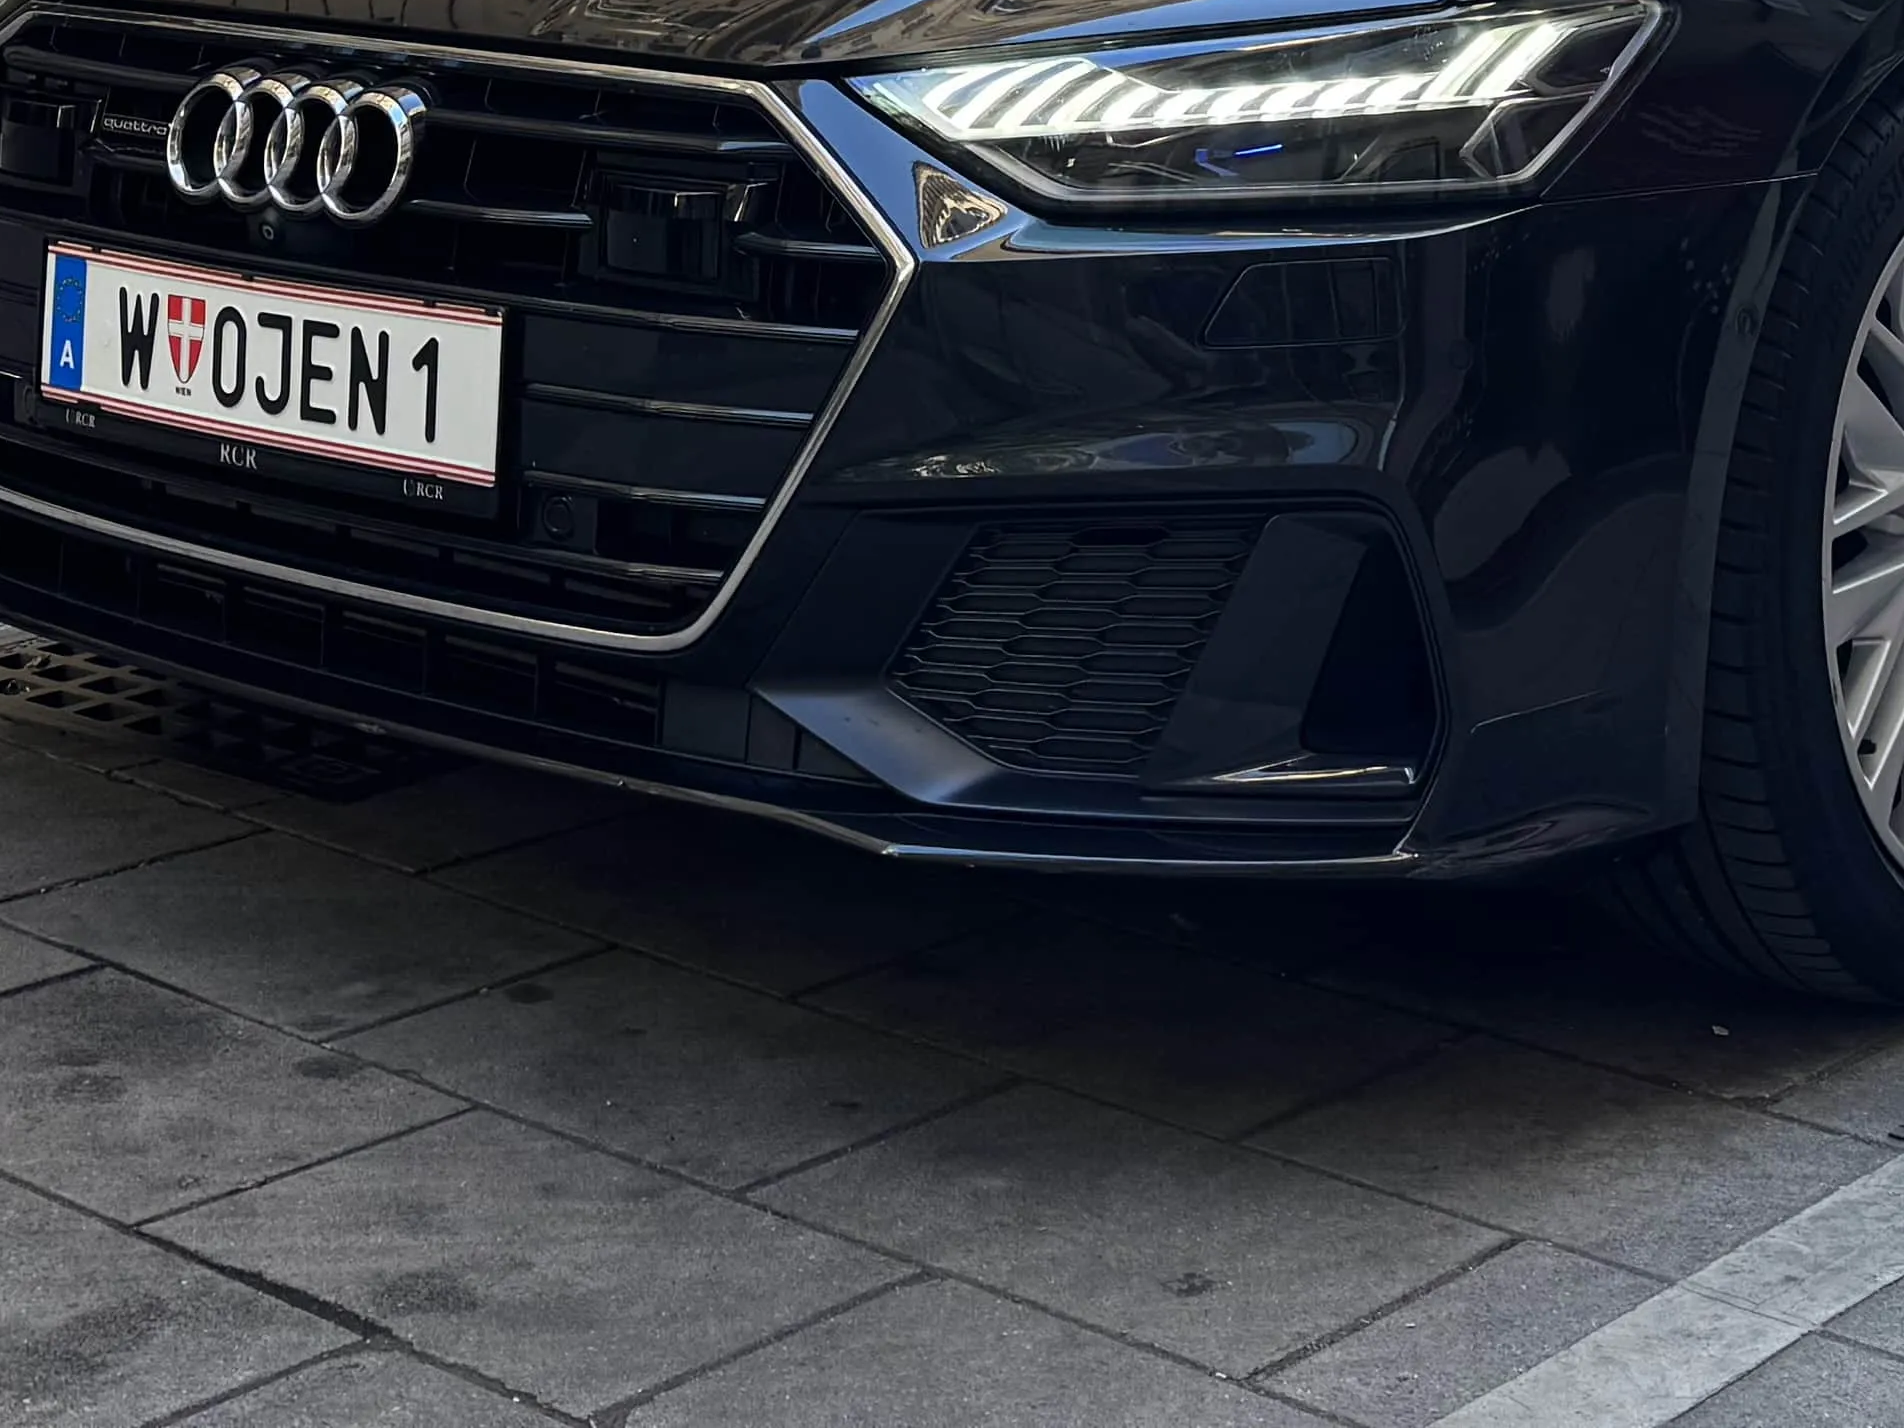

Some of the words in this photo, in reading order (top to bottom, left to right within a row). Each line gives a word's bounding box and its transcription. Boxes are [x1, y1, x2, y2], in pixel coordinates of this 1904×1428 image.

[104, 118, 167, 136] quattro
[118, 286, 160, 391] W
[59, 340, 75, 370] A
[220, 443, 257, 470] RCR
